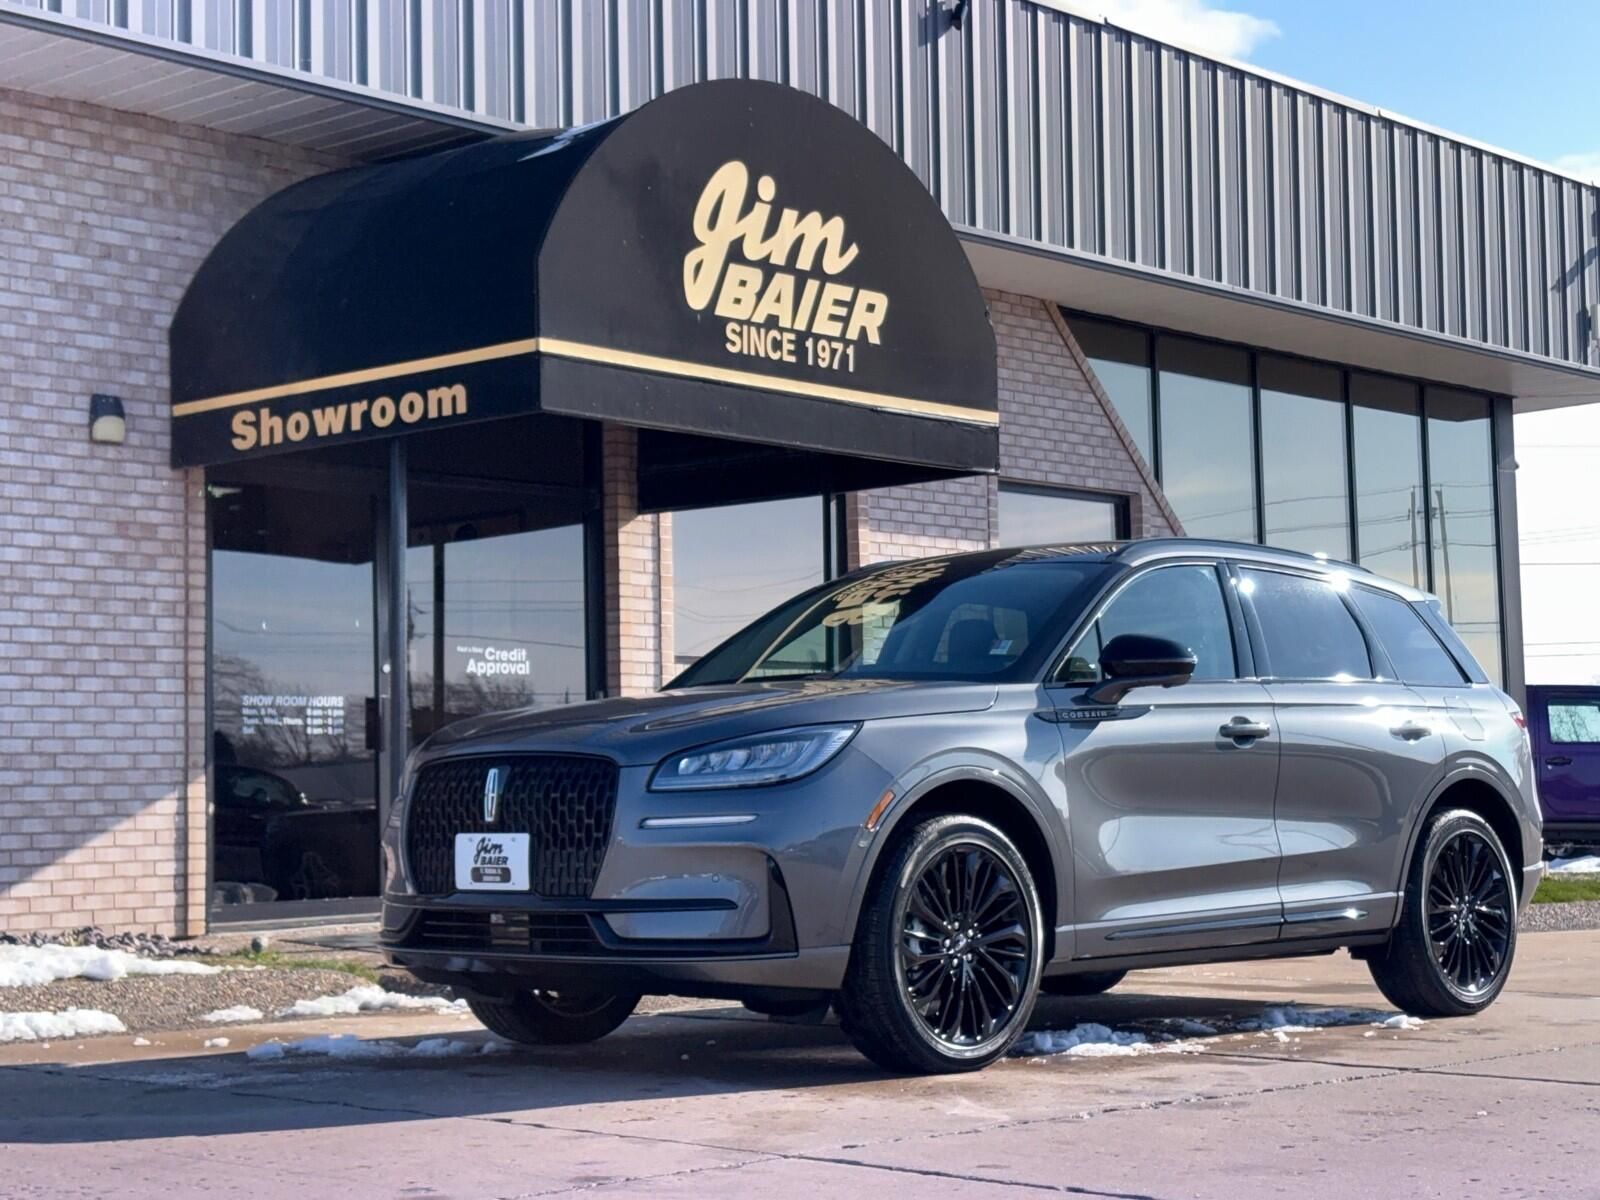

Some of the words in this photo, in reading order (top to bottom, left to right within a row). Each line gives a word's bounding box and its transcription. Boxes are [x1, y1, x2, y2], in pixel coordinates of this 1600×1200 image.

[683, 160, 859, 311] Jim
[714, 263, 888, 345] BAIER
[725, 322, 796, 363] SINCE
[805, 337, 855, 373] 1971
[231, 384, 467, 451] Showroom
[466, 658, 530, 677] Approval
[484, 647, 527, 661] Credit
[242, 695, 273, 706] SHOW
[275, 695, 306, 706] ROOM
[308, 696, 344, 707] HOURS
[473, 837, 503, 865] Jim
[481, 856, 509, 865] BAIER
